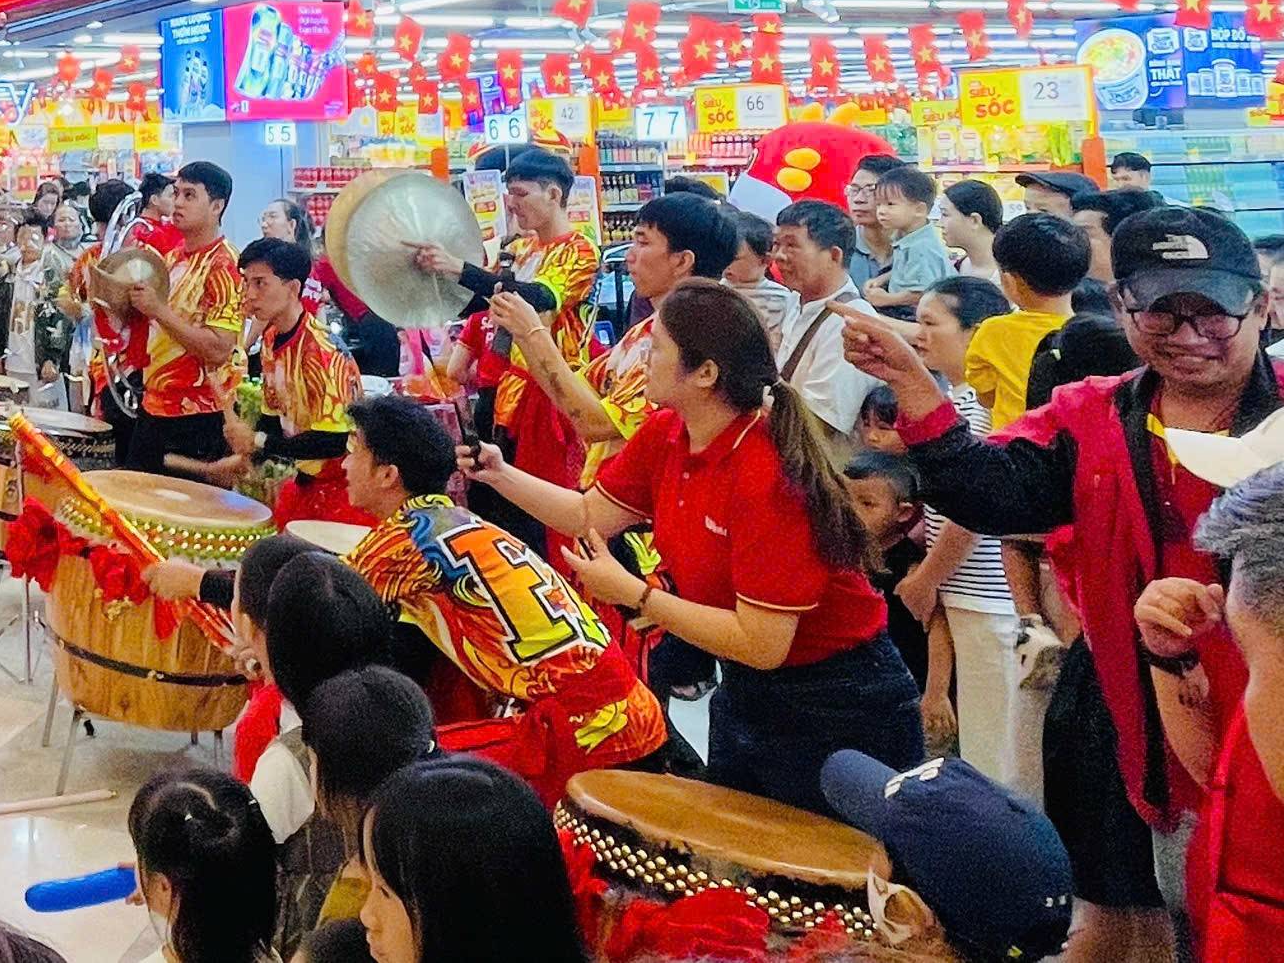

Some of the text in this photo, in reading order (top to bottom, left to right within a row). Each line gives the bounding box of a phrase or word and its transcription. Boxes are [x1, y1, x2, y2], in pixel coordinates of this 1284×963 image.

[707, 104, 735, 125] SỐC
[976, 94, 1015, 118] SỐC
[281, 125, 291, 141] 5
[489, 117, 520, 140] 6 6
[644, 111, 679, 135] 7 7
